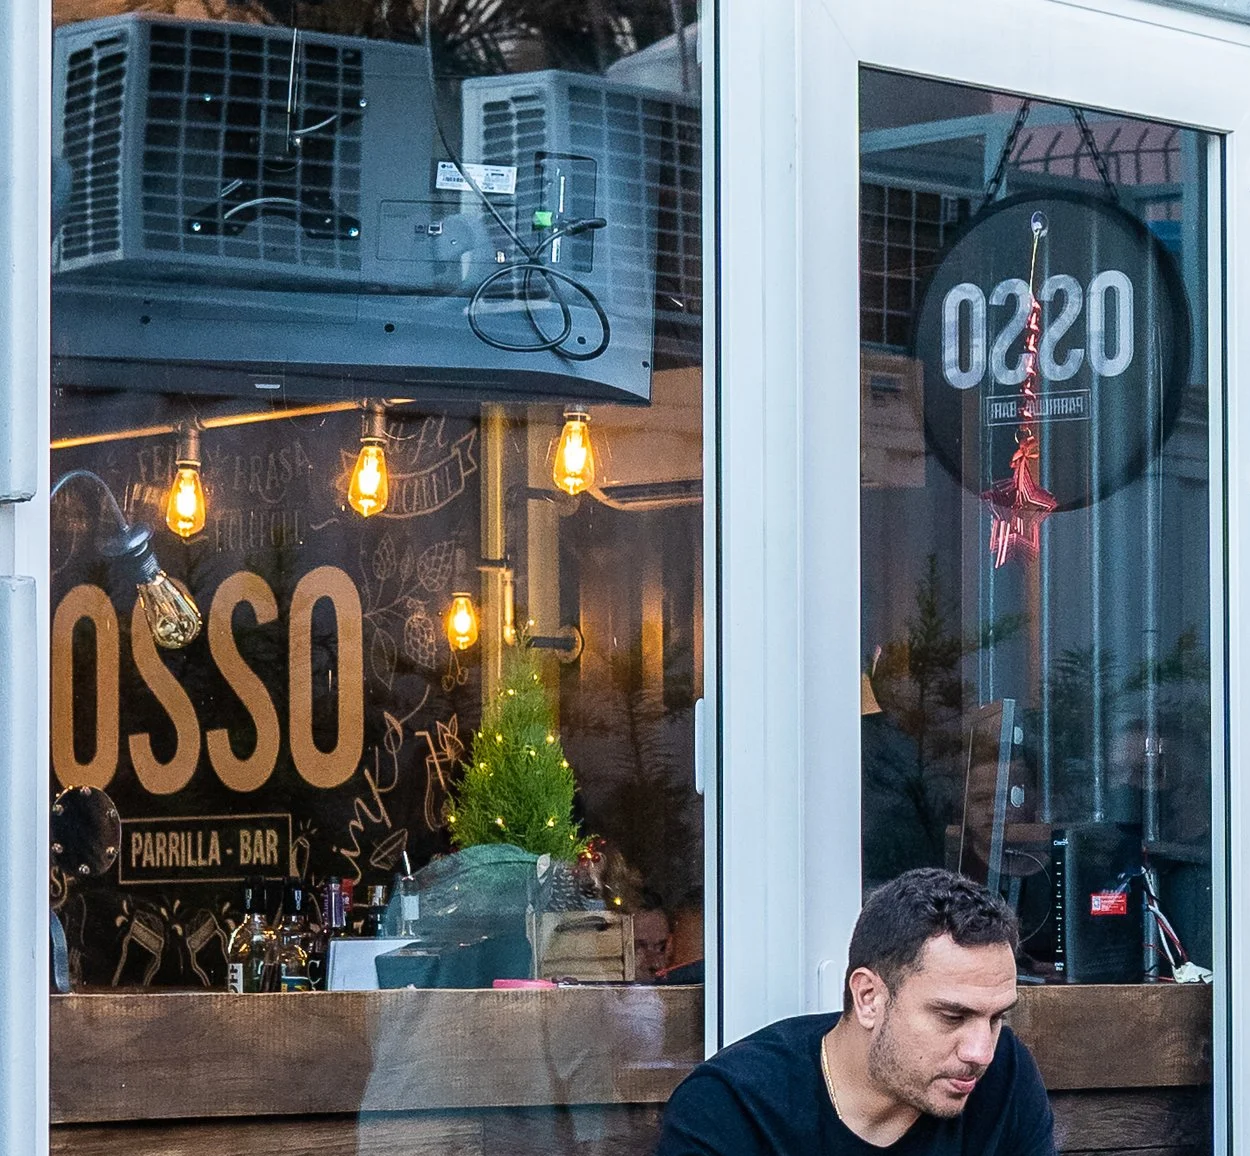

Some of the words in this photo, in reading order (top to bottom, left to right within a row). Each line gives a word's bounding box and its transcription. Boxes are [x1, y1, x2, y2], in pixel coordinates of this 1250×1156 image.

[52, 565, 364, 794] OSSO
[131, 831, 222, 868] PARRILLA
[239, 829, 279, 866] BAR
